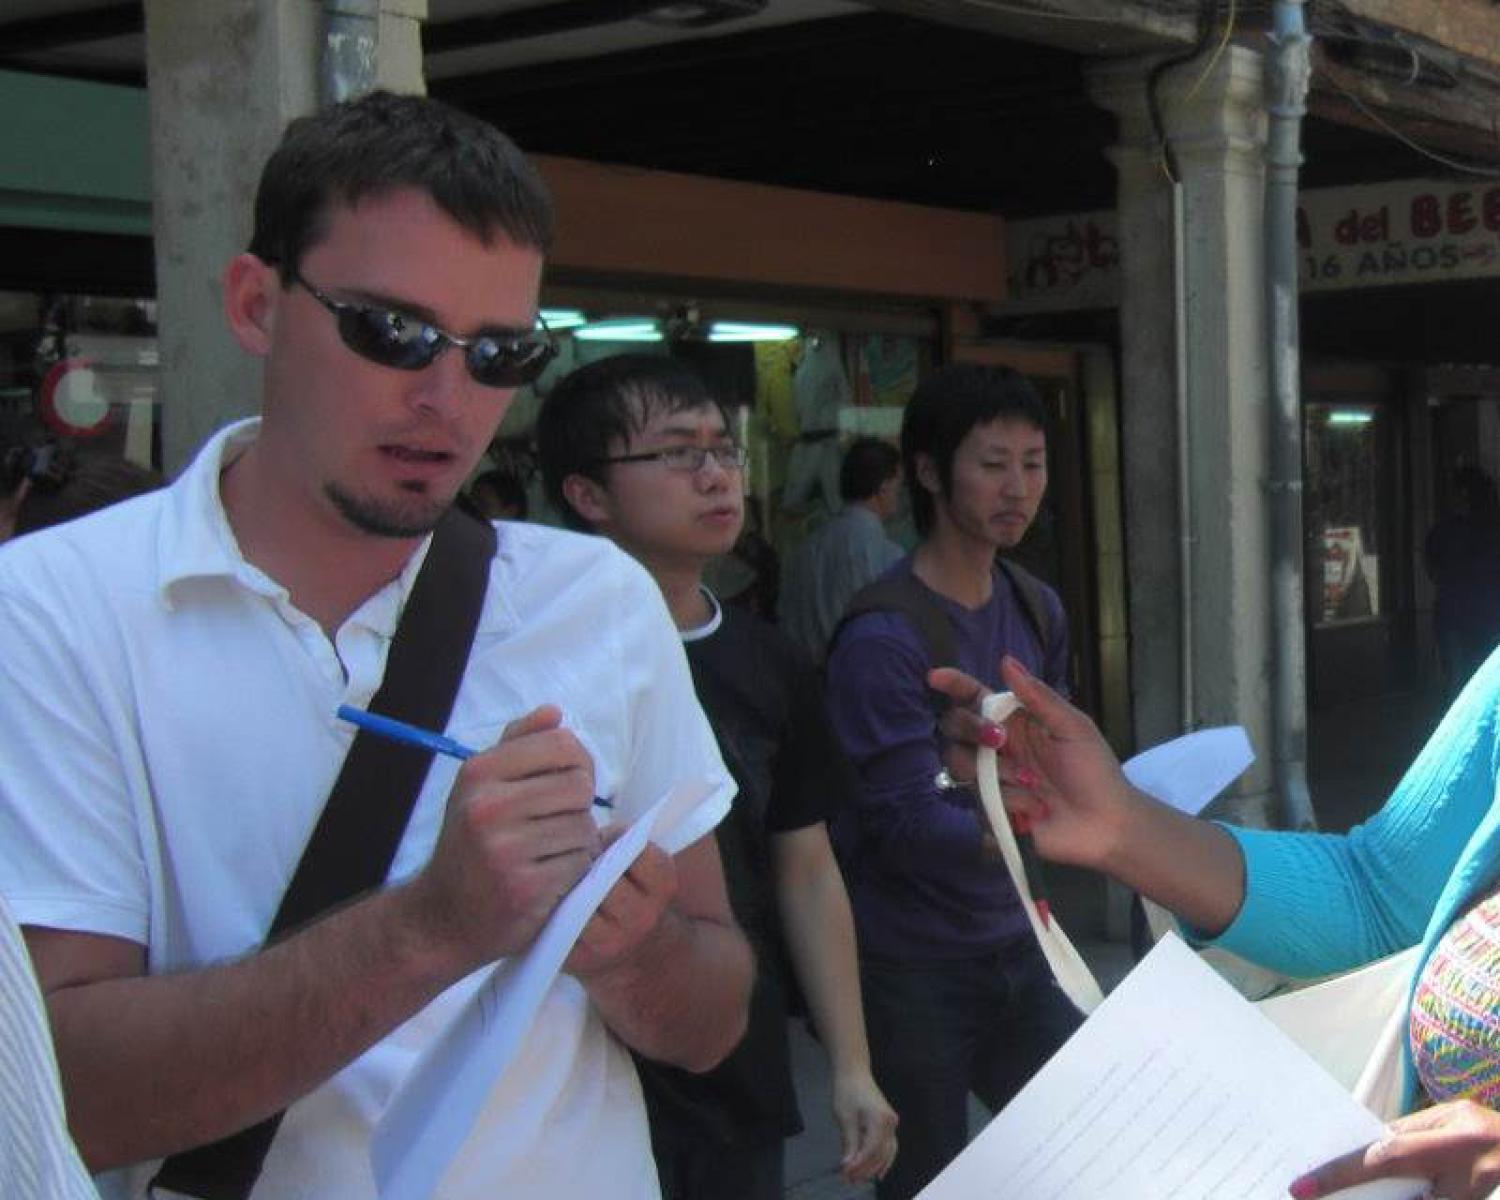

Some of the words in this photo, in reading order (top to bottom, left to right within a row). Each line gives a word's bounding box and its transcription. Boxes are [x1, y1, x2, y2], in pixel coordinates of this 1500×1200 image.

[1335, 206, 1389, 246] del
[1307, 254, 1341, 279] 16
[1357, 241, 1459, 276] AÑOS
